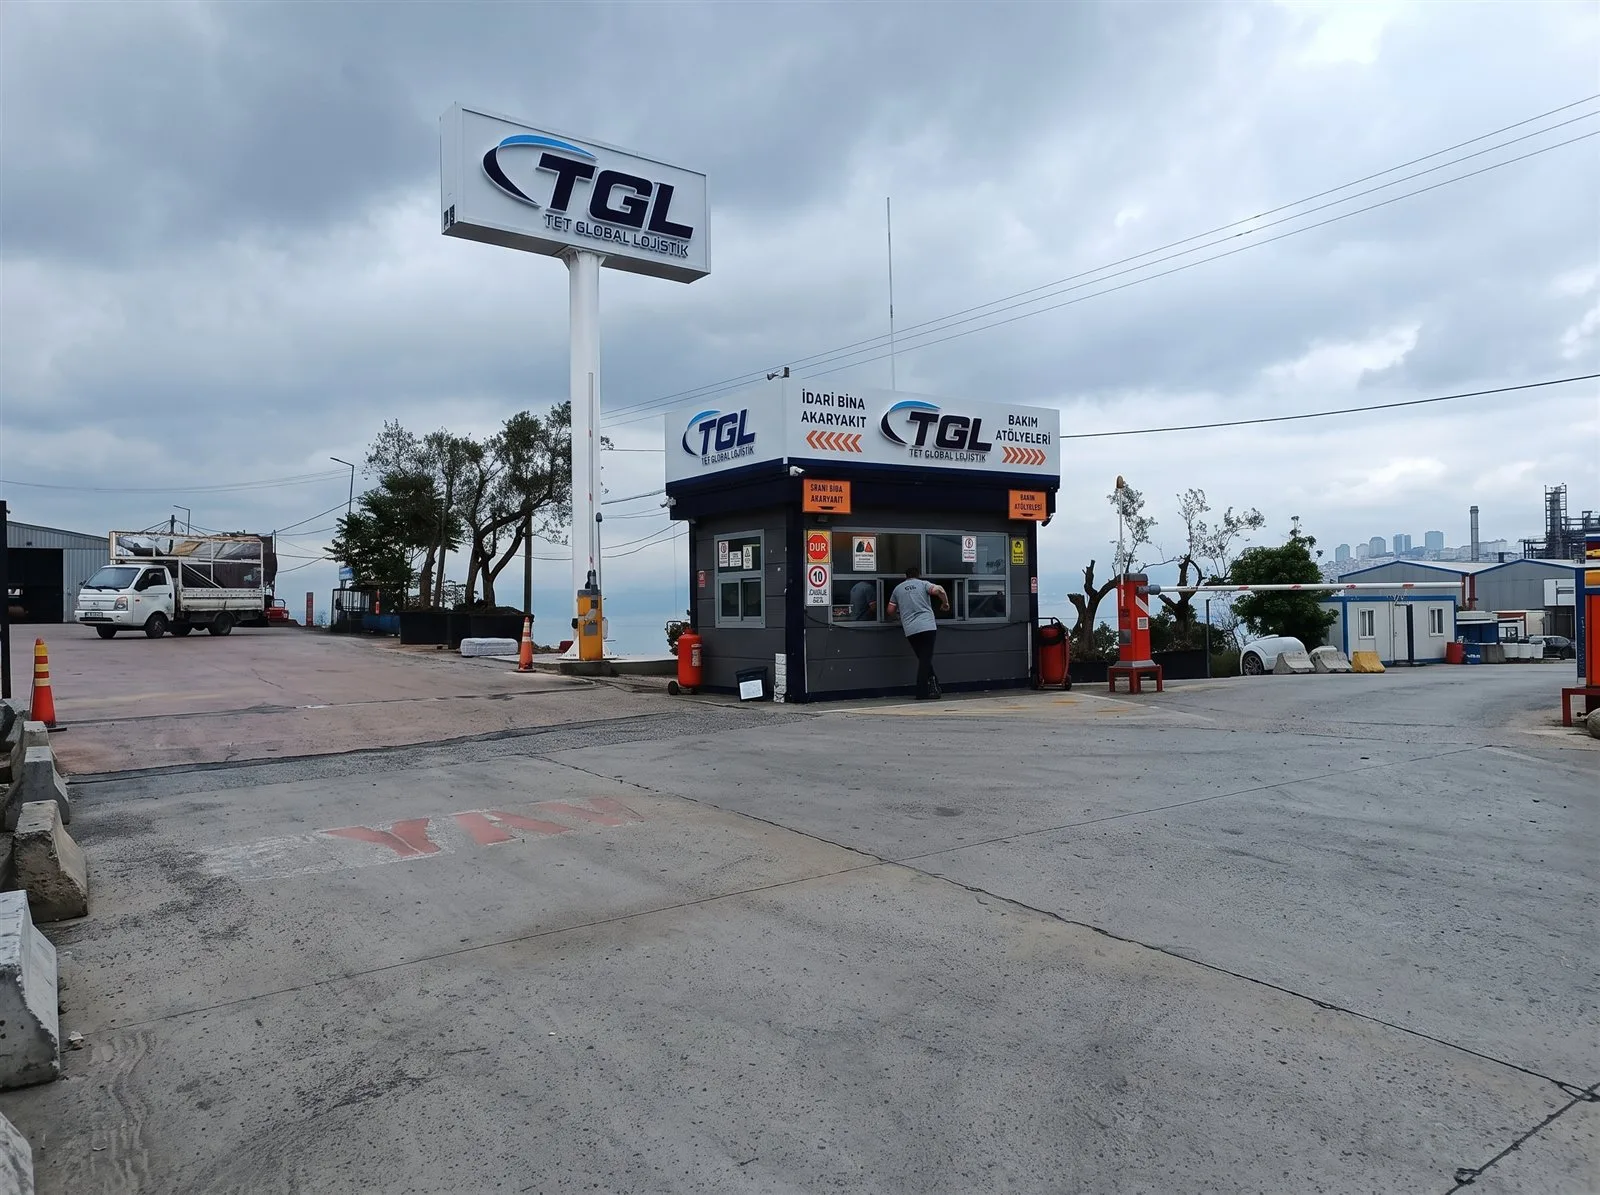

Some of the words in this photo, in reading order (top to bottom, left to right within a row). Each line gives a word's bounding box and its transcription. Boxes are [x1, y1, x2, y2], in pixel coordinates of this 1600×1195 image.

[537, 152, 694, 239] TGL
[545, 214, 571, 231] TET
[576, 221, 630, 243] GLOBAL
[633, 234, 689, 258] LOJİSTİK
[802, 388, 834, 407] İDARİ
[837, 393, 865, 410] BİNA
[801, 410, 867, 428] AKARYAKIT
[1008, 414, 1038, 428] BAKIM
[699, 409, 756, 456] TGL
[907, 411, 992, 452] TGL
[996, 428, 1051, 445] ATÖLYELERİ
[908, 448, 922, 458] TET
[924, 450, 954, 460] GLOBAL
[809, 542, 826, 552] DUR
[813, 571, 823, 583] 10
